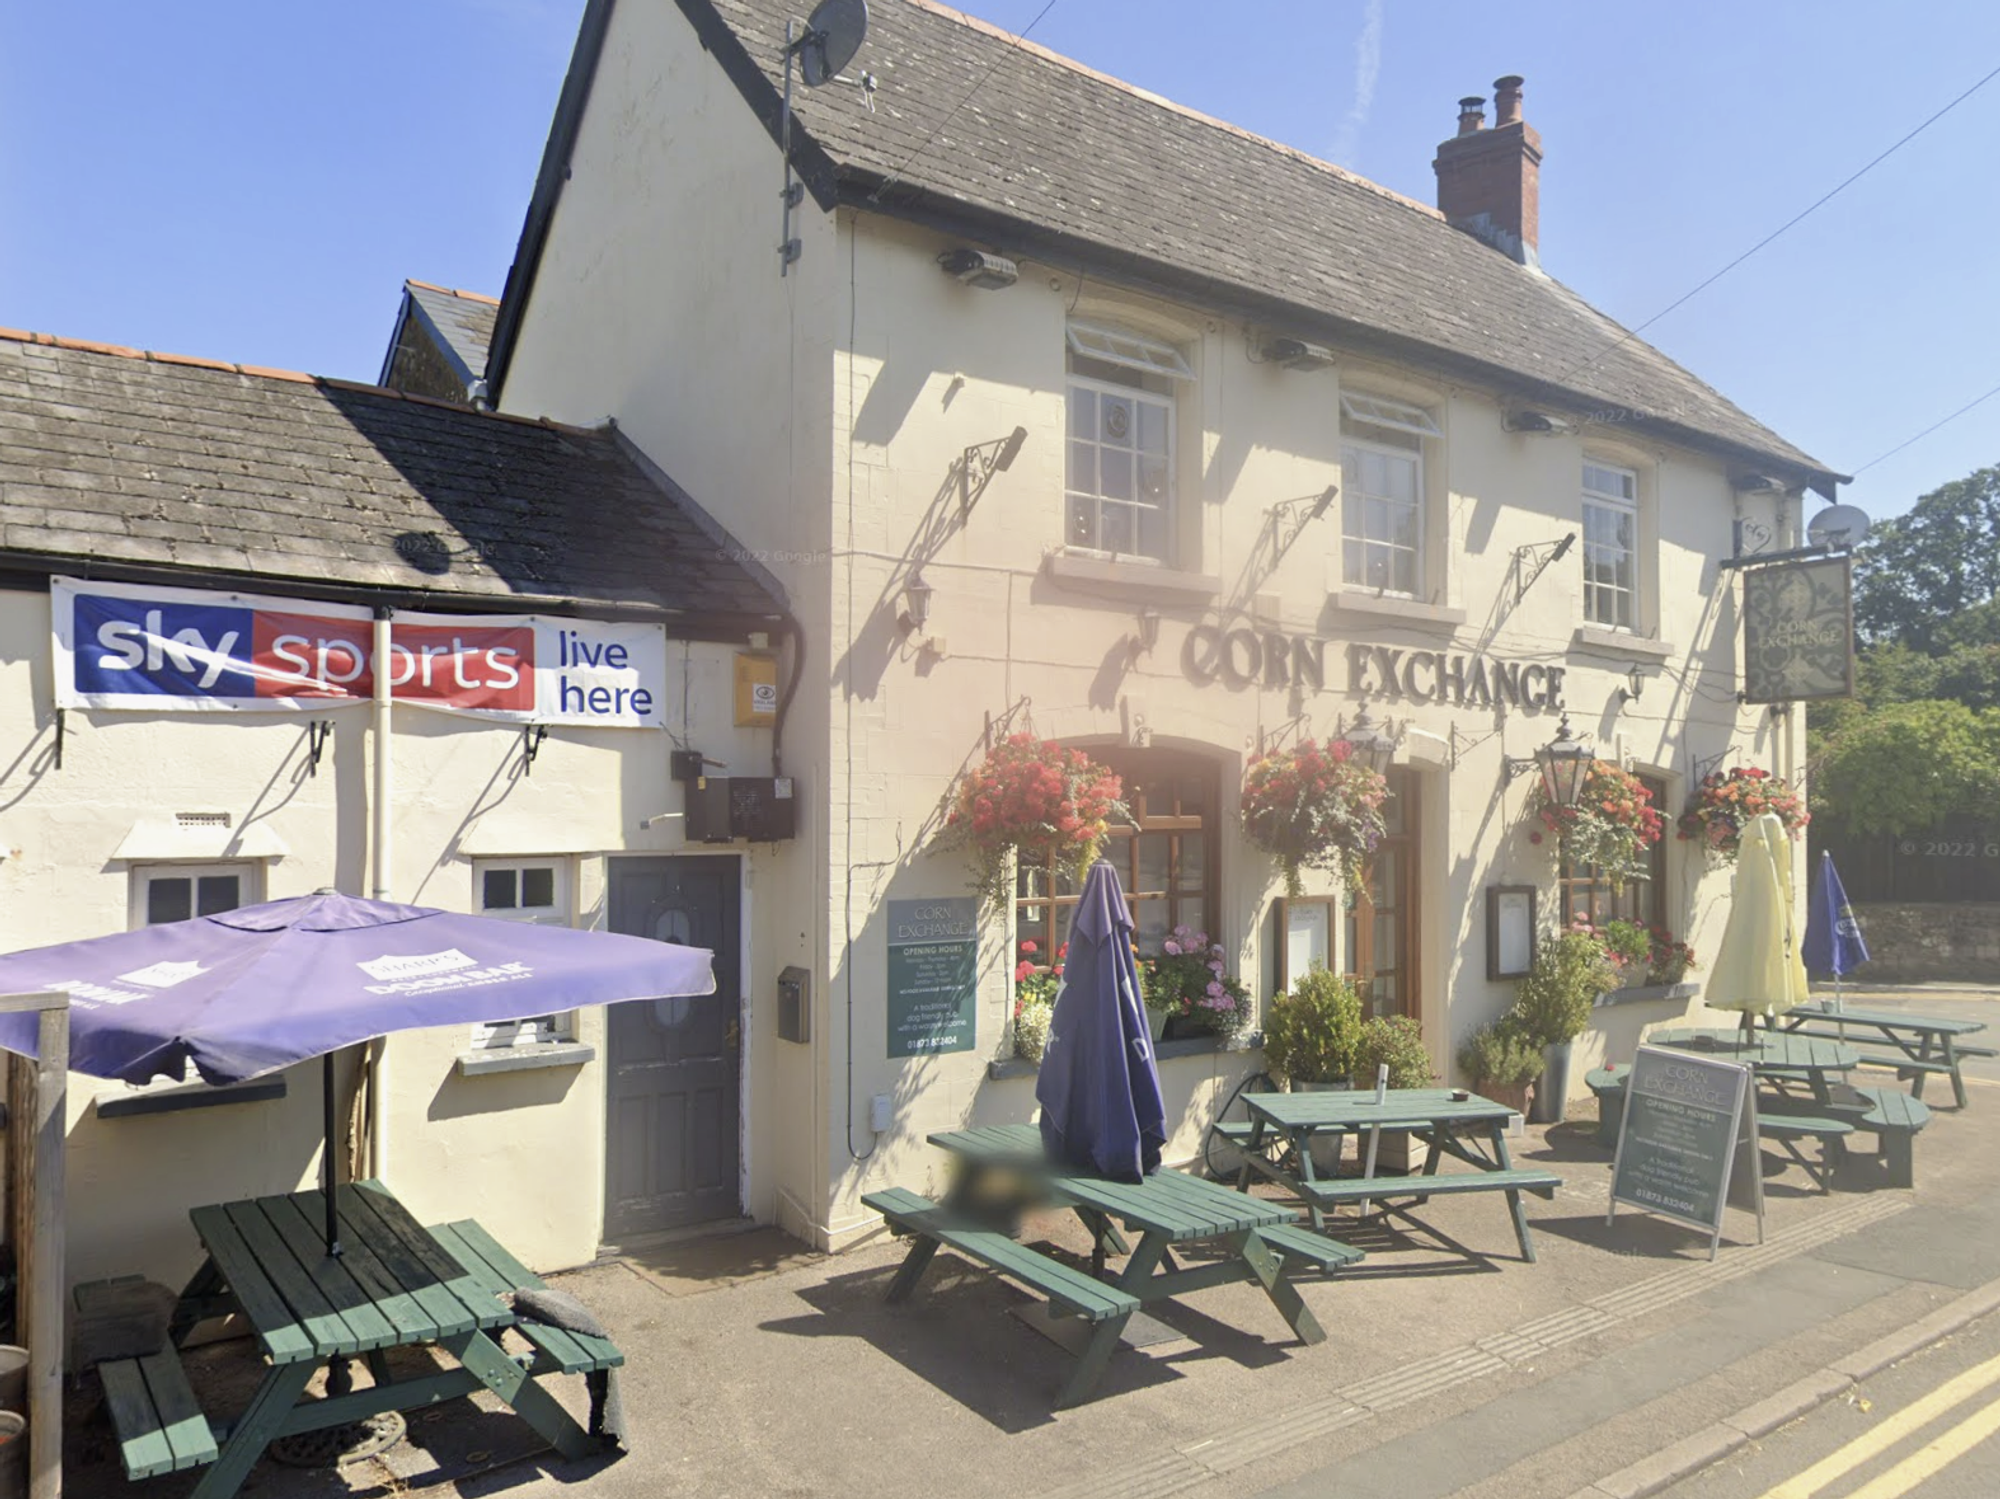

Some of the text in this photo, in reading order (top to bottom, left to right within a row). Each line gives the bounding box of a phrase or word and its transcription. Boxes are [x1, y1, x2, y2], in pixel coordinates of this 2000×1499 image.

[1777, 619, 1818, 633] CORN
[97, 610, 519, 690] sky sports
[560, 630, 628, 669] live
[1758, 631, 1839, 648] EXCHANGE
[1183, 626, 1565, 711] CORN EXCHANGE
[560, 675, 653, 715] here
[914, 906, 951, 920] CORN
[898, 922, 968, 938] EXCHANGE
[903, 945, 962, 956] OPENING HOURS
[363, 974, 472, 995] DOOM
[463, 962, 534, 979] BAR
[1665, 1064, 1708, 1084] CORN
[1644, 1075, 1726, 1107] EXCHANGE
[1645, 1099, 1685, 1115] OPENING
[1687, 1108, 1716, 1122] HOURS
[1636, 1189, 1694, 1212] 01873 832404
